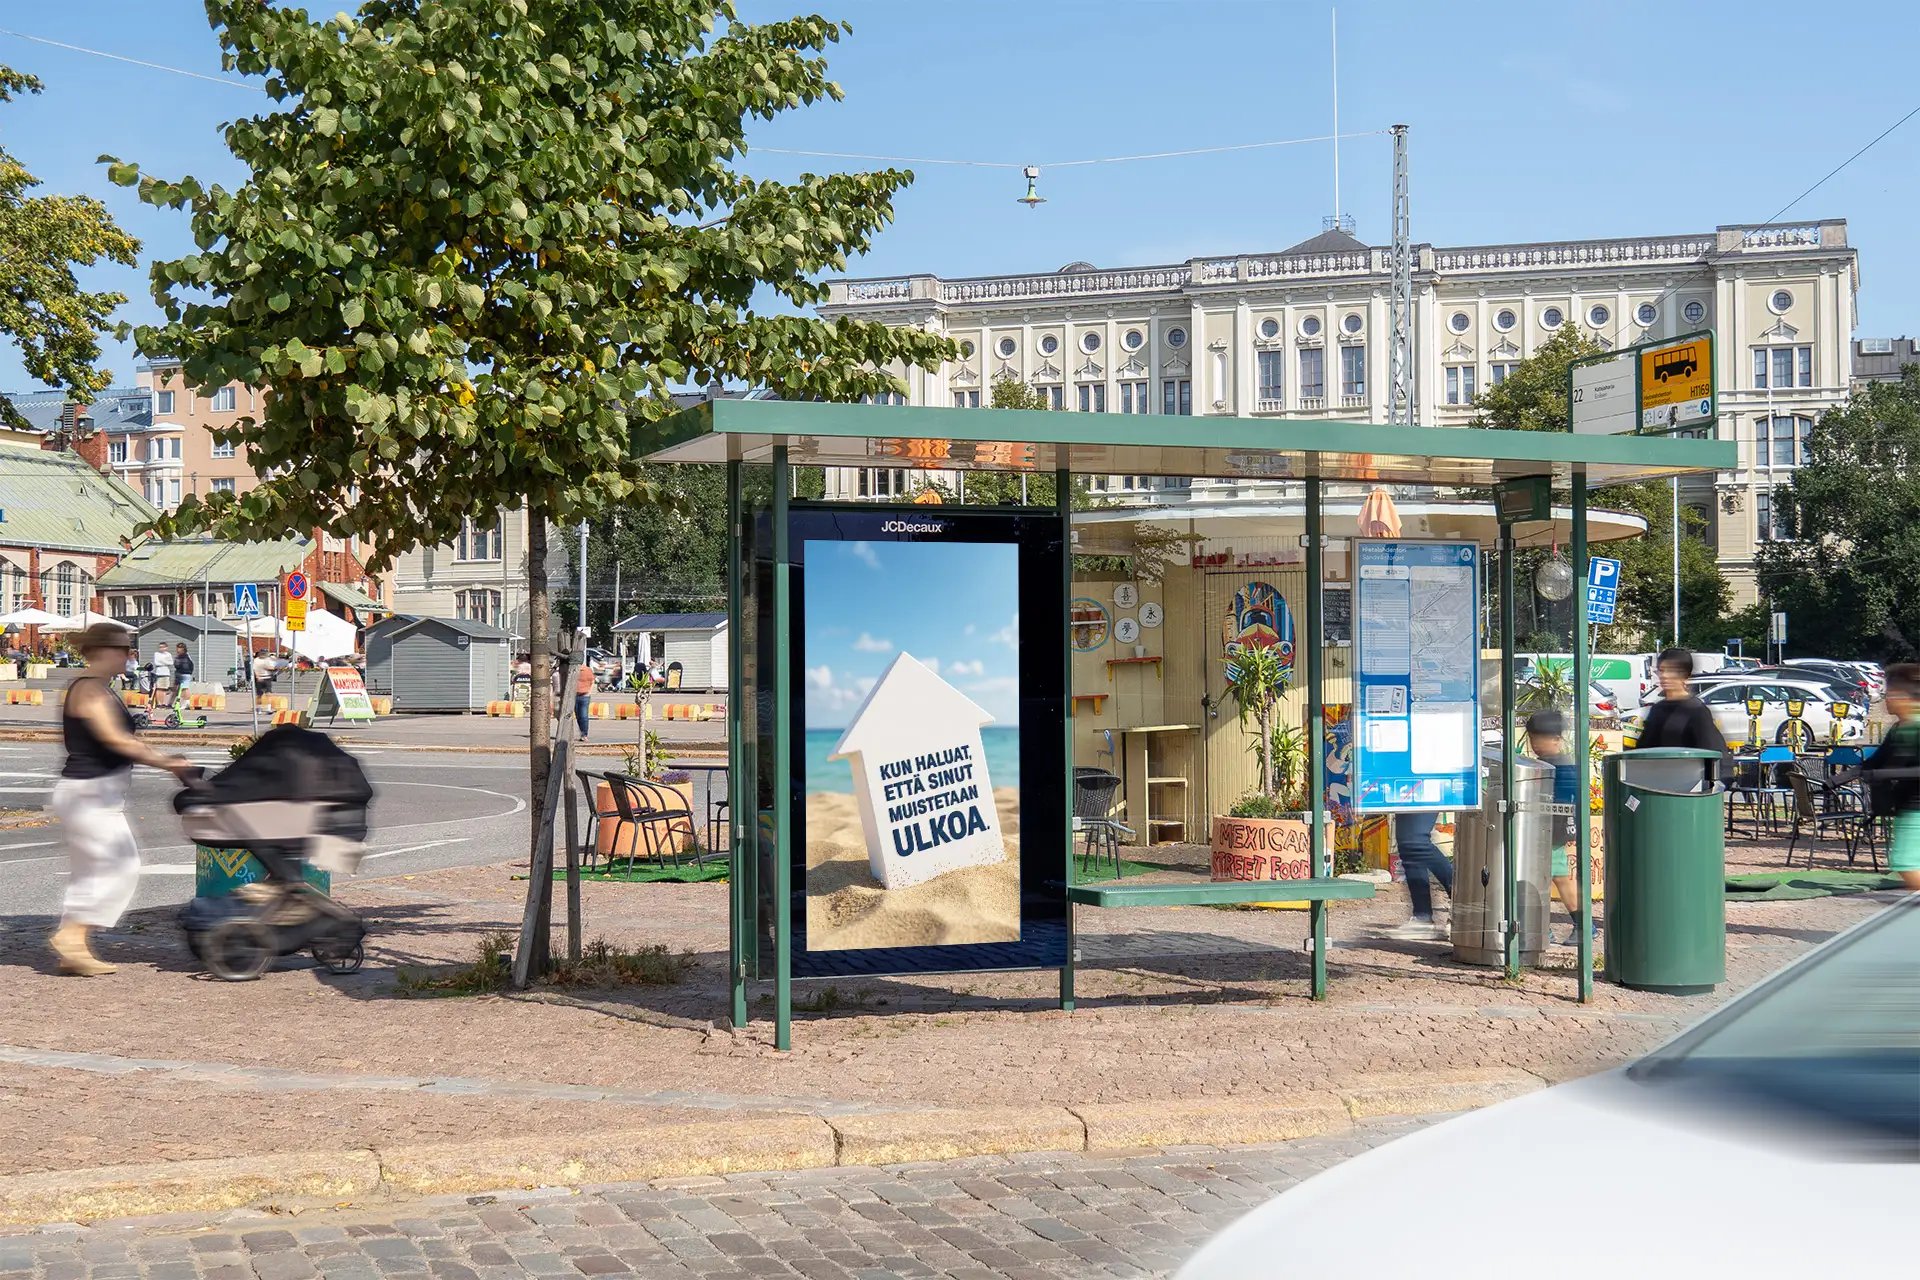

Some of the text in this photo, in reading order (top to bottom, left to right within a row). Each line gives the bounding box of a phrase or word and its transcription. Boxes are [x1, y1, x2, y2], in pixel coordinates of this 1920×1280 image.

[1573, 388, 1584, 403] 22
[881, 520, 943, 533] JCDecaux
[1594, 559, 1615, 586] P
[879, 744, 972, 781] KUN HALUAT,
[883, 763, 973, 802] ETTÄ SINUT
[888, 784, 979, 823] MUISTETAAN
[892, 805, 991, 858] ULKOA.
